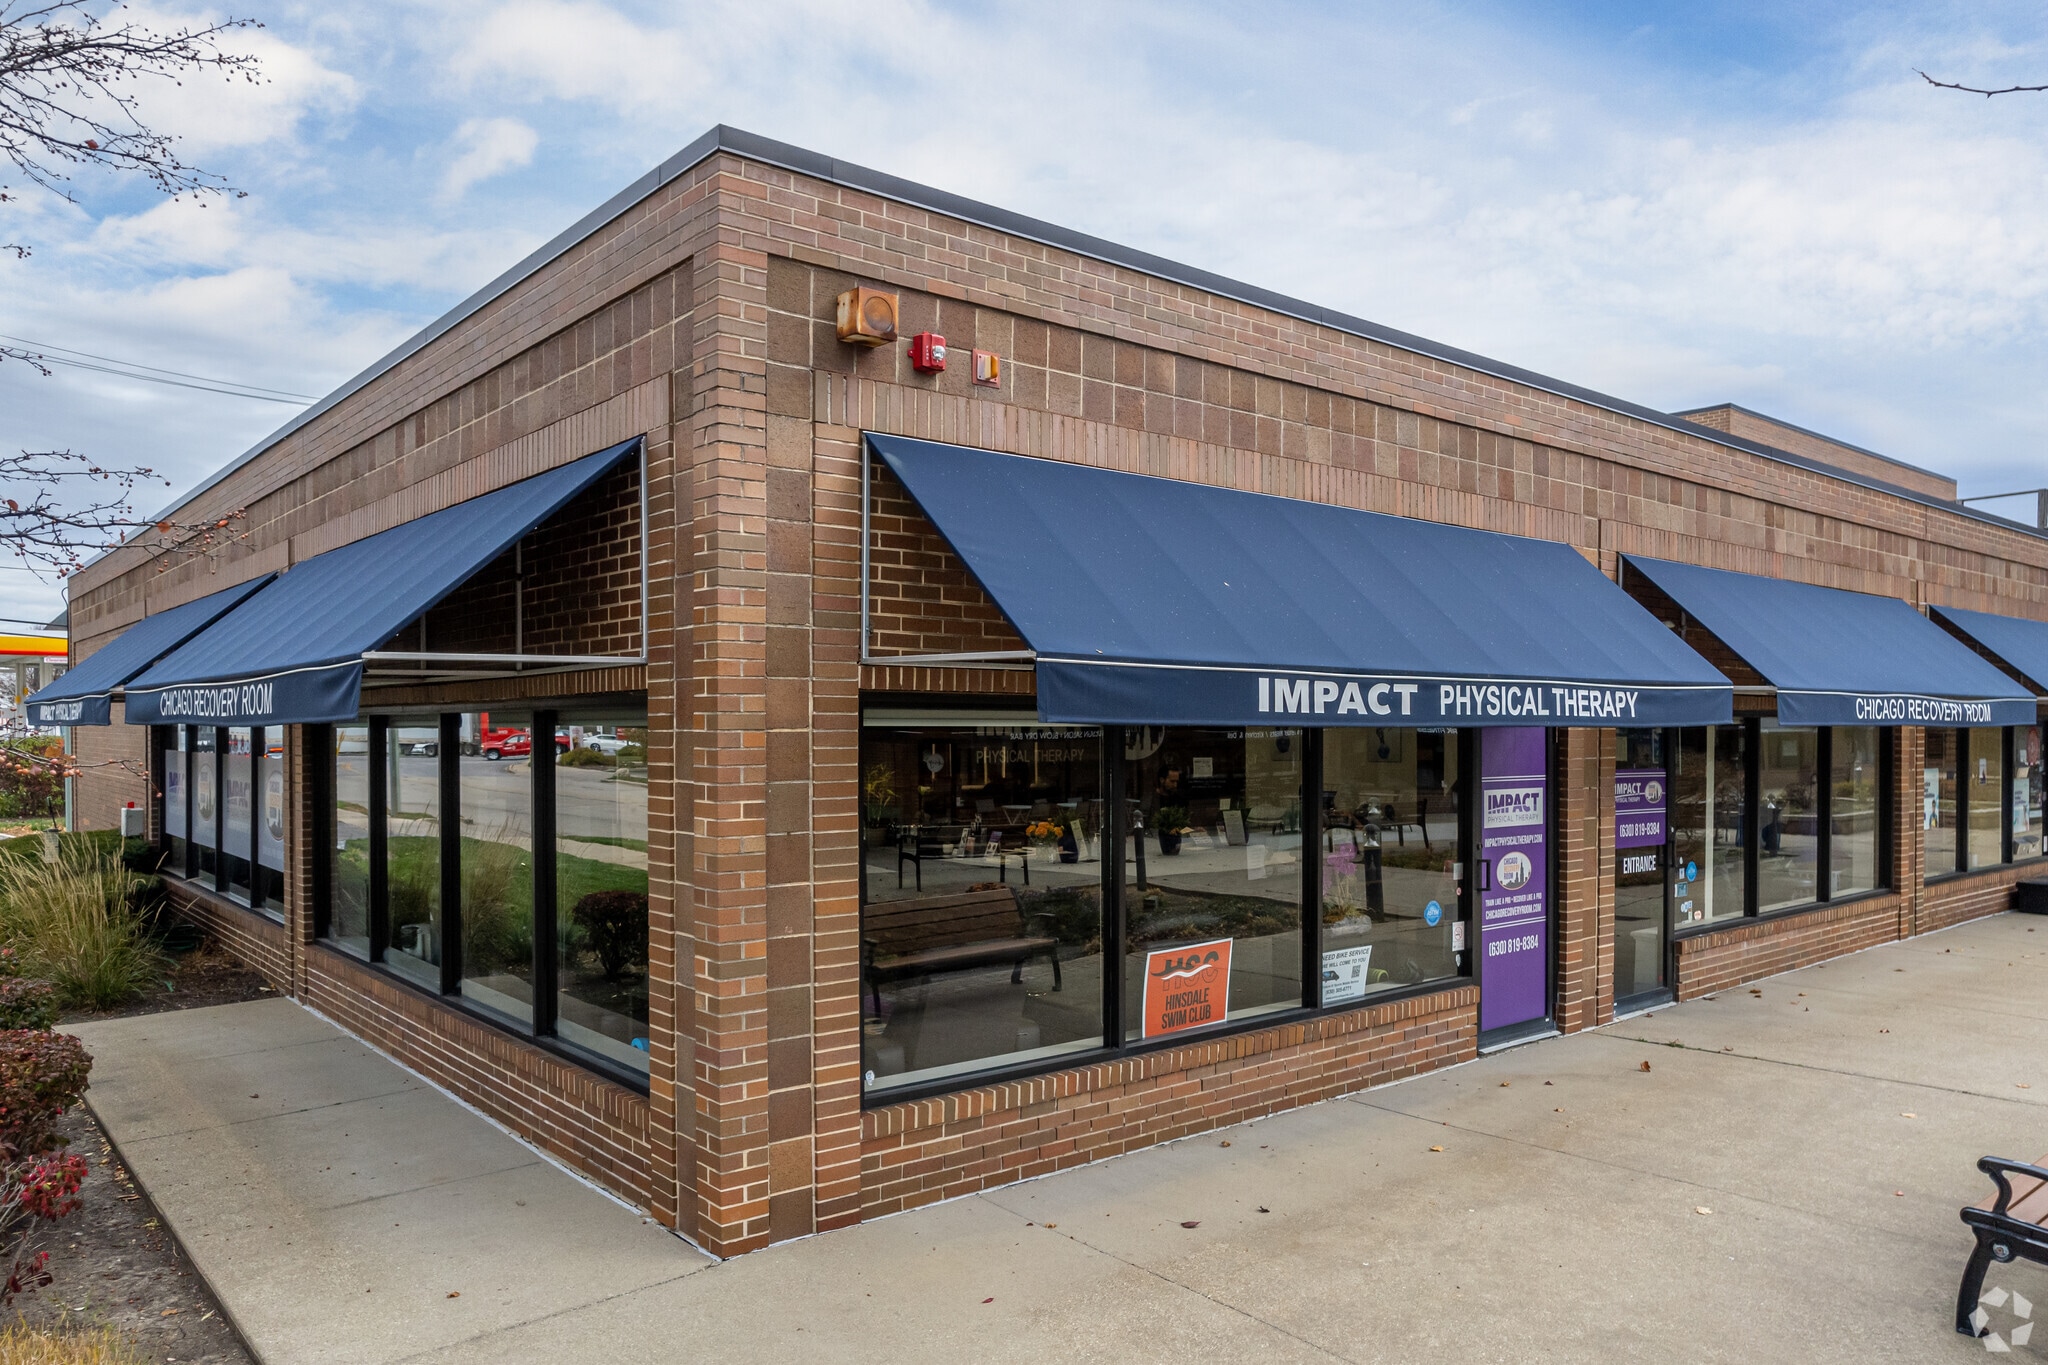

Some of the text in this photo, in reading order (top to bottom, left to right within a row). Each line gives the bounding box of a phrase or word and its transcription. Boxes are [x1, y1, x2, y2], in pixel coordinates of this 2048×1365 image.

[160, 682, 273, 717] CHICAGO RECOVERY ROOM
[1258, 677, 1639, 718] IMPACT PHYSICAL THERAPY
[40, 705, 55, 721] IMPACT
[1856, 698, 1991, 722] CHICAGO RECOVERY ROOM
[976, 749, 1085, 763] PHYSICAL THERAPY
[1615, 783, 1641, 795] IMPACT
[1487, 792, 1540, 814] IMPACT
[1487, 813, 1539, 823] PHYSICAL THERAPY
[1619, 822, 1660, 838] (630) 819-8384
[1503, 856, 1518, 865] CHICAGO
[1623, 855, 1657, 874] ENTRANCE
[1485, 903, 1542, 920] CHICAGORECOVERYROOM.COM
[1349, 948, 1370, 957] SERVICE
[1488, 934, 1539, 957] (630) 819-8384
[1165, 987, 1210, 1011] HINSDALE
[1161, 1004, 1211, 1029] SWIM CLUB
